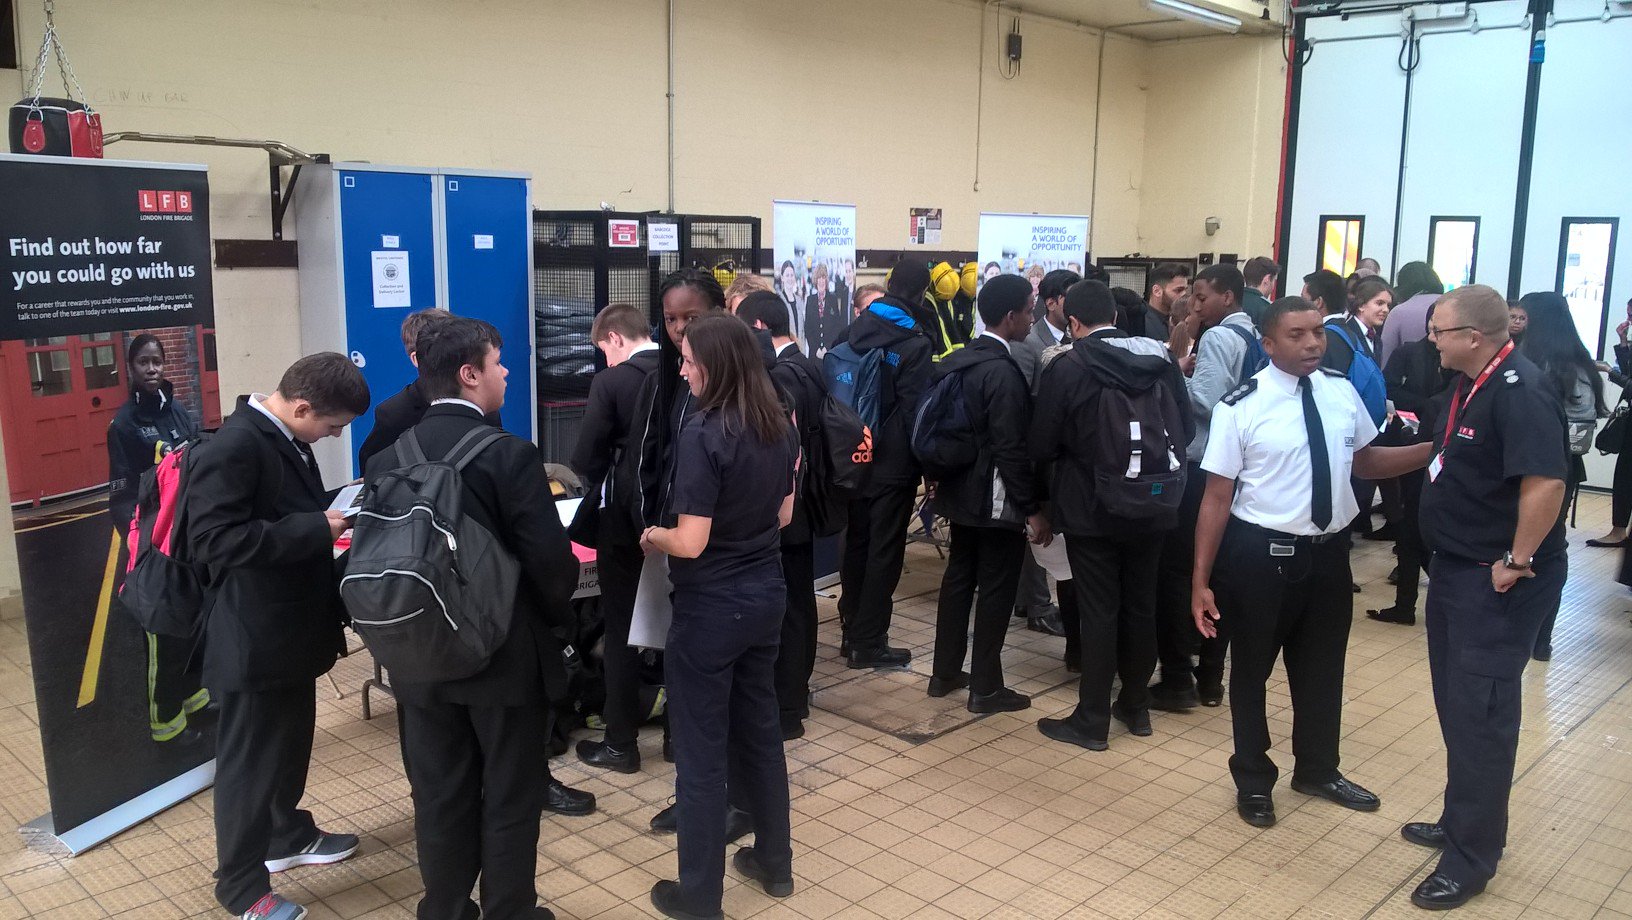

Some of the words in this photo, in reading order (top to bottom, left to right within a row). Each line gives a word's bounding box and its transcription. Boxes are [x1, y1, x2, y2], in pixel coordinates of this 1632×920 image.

[143, 193, 189, 209] LFB
[815, 216, 842, 226] INSPIRING
[816, 227, 821, 236] A
[821, 227, 841, 236] WORLD
[842, 227, 850, 236] OF
[1032, 226, 1067, 234] INSPIRING
[816, 237, 853, 246] OPPORTUNITY
[1032, 234, 1037, 242] A
[1039, 234, 1065, 243] WORLD
[1067, 235, 1077, 243] OF
[9, 237, 54, 256] Find
[59, 238, 91, 256] out
[94, 236, 133, 255] how
[136, 236, 162, 254] far
[1031, 243, 1082, 251] OPPORTUNITY
[12, 270, 51, 291] you
[56, 263, 106, 283] could
[111, 267, 133, 286] go
[136, 261, 175, 279] with
[178, 265, 195, 278] us
[16, 302, 30, 310] For
[67, 299, 90, 307] rewards
[122, 295, 152, 303] community
[52, 310, 59, 318] of
[85, 308, 100, 316] today
[107, 306, 119, 314] visit
[119, 302, 193, 313] www.london-fire.gov.uk
[584, 566, 597, 576] FIR
